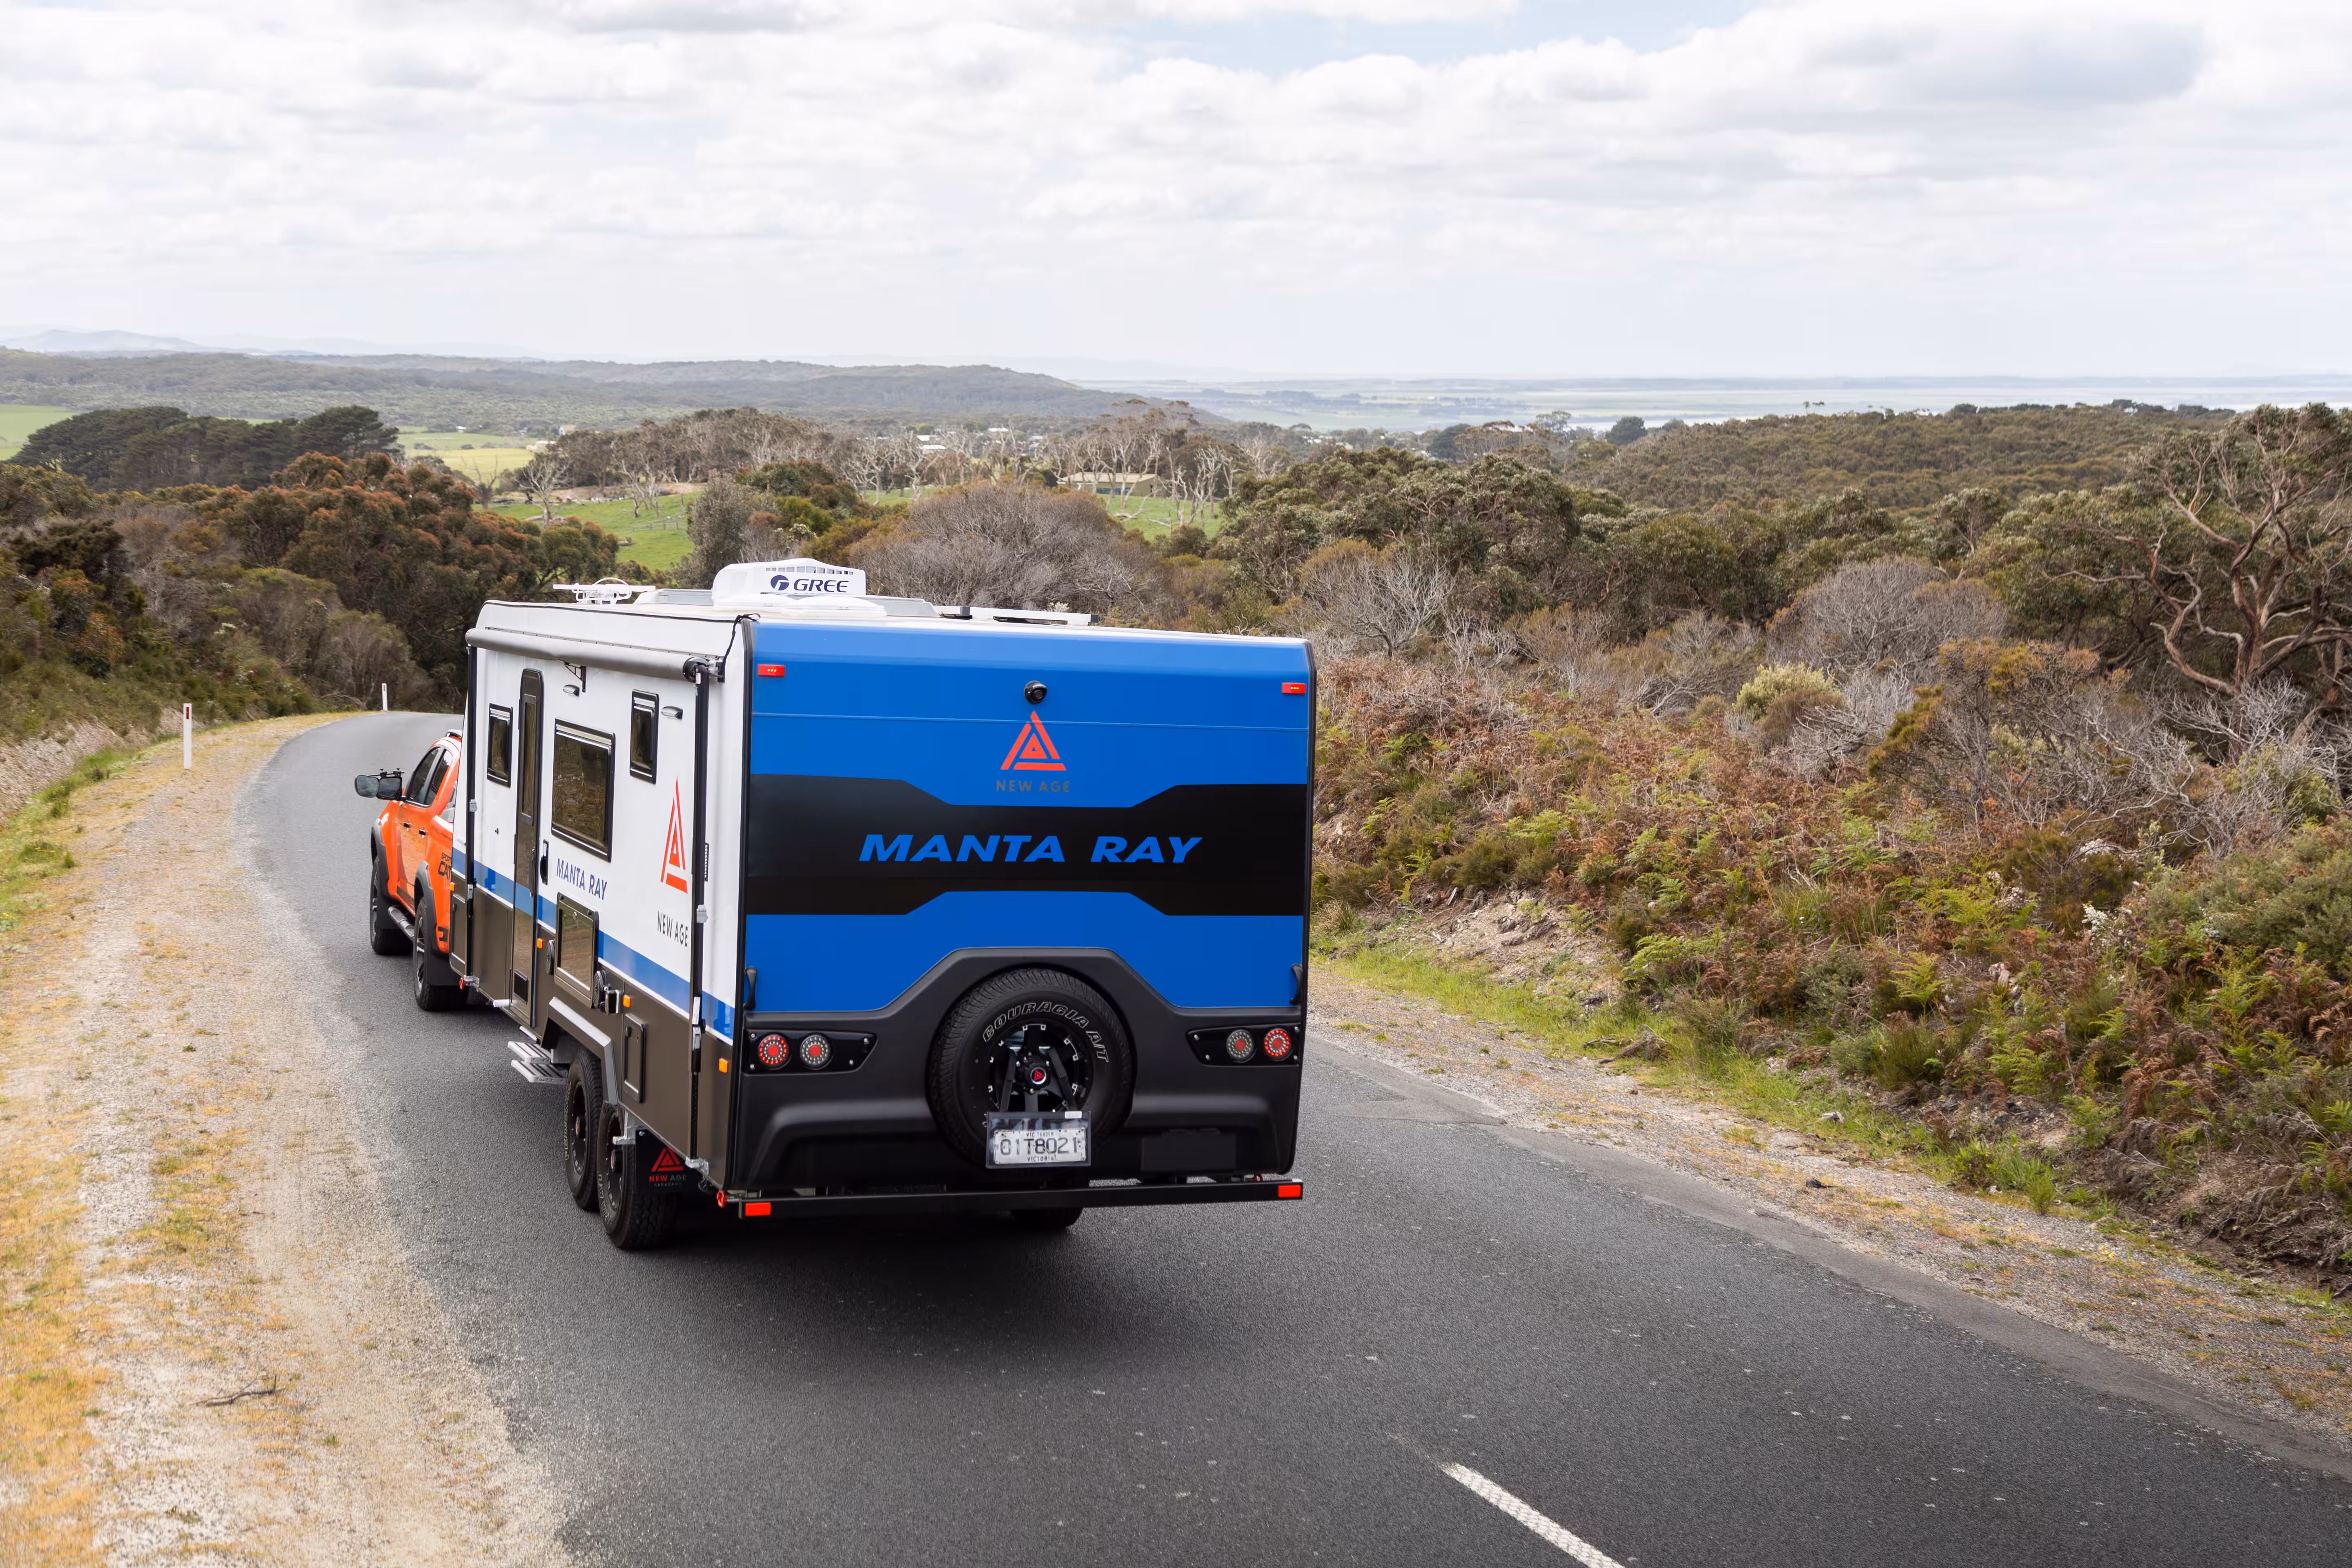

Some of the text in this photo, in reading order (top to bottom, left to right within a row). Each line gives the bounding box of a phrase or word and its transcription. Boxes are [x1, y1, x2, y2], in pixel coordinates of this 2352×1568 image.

[794, 579, 849, 592] GREE
[996, 780, 1070, 793] NEW AGE
[859, 834, 1203, 863] MANTA RAY
[556, 858, 607, 900] MANTA RAY
[657, 911, 688, 947] NEW AGE
[983, 1002, 1089, 1042] COURAGIA
